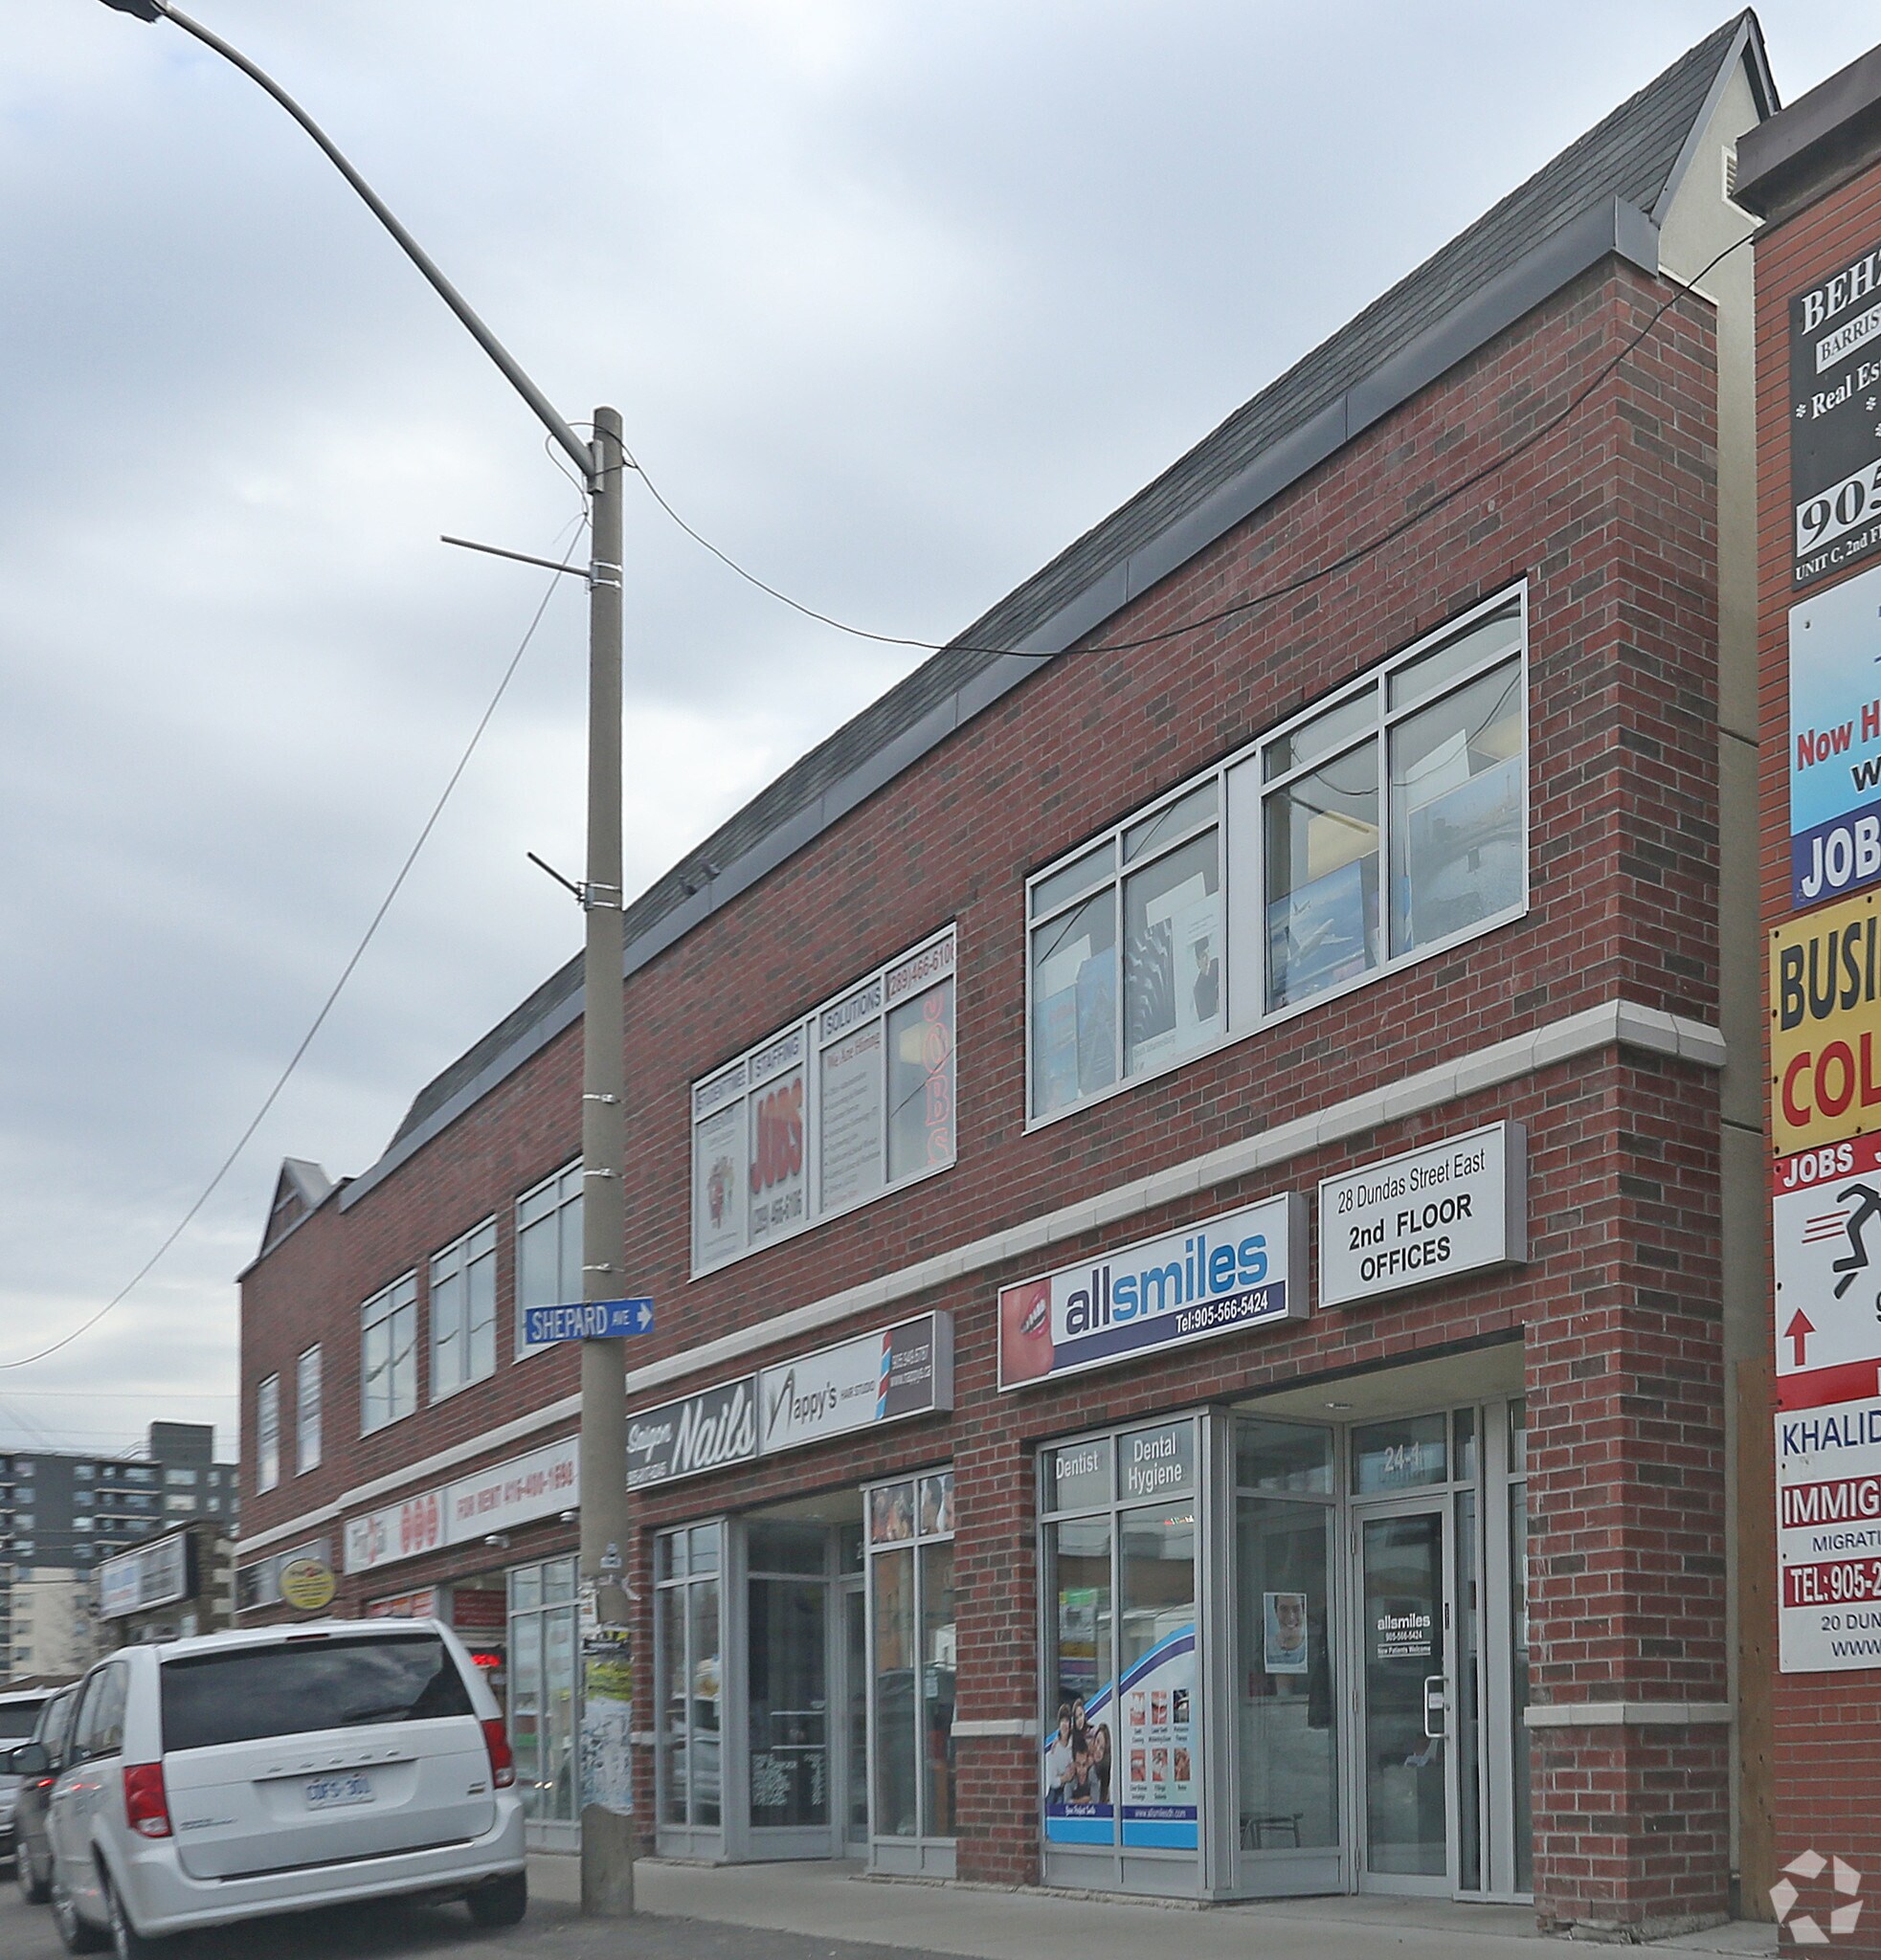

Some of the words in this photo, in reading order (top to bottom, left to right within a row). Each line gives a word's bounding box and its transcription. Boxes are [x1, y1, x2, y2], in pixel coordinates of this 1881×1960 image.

[1802, 247, 1881, 335] BEH
[1821, 308, 1881, 362] BARRIS
[1811, 374, 1852, 419] Real
[1857, 359, 1881, 391] Es
[1795, 552, 1829, 581] UNIT
[1830, 546, 1844, 563] C,
[1846, 532, 1868, 556] 2nd
[1797, 721, 1853, 771] Now
[1801, 814, 1881, 898] JOB
[1780, 916, 1881, 1032] BUSI
[826, 987, 881, 1035] SOLUTIONS
[756, 1036, 798, 1079] STAFFING
[1781, 1032, 1881, 1127] COL
[750, 1078, 803, 1195] JOBS
[1337, 1189, 1354, 1214] 28
[1357, 1176, 1406, 1209] Dundas
[1410, 1160, 1450, 1192] Street
[1454, 1147, 1486, 1178] East
[1783, 1144, 1855, 1188] JOBS
[1349, 1218, 1385, 1251] 2nd
[1397, 1193, 1472, 1236] FLOOR
[1360, 1236, 1451, 1281] OFFICES
[1065, 1234, 1268, 1335] allsmiles
[531, 1305, 608, 1340] SHEPARD
[612, 1309, 631, 1325] AVE
[671, 1384, 757, 1475] Nails
[1133, 1432, 1176, 1463] Dental
[1782, 1411, 1881, 1456] KHALID
[1056, 1450, 1099, 1481] Dentist
[1128, 1462, 1182, 1495] Hygiene
[1783, 1480, 1881, 1525] IMMIG
[1377, 1613, 1430, 1631] allsmiles
[1821, 1615, 1842, 1632] 20
[1846, 1612, 1881, 1630] DUN
